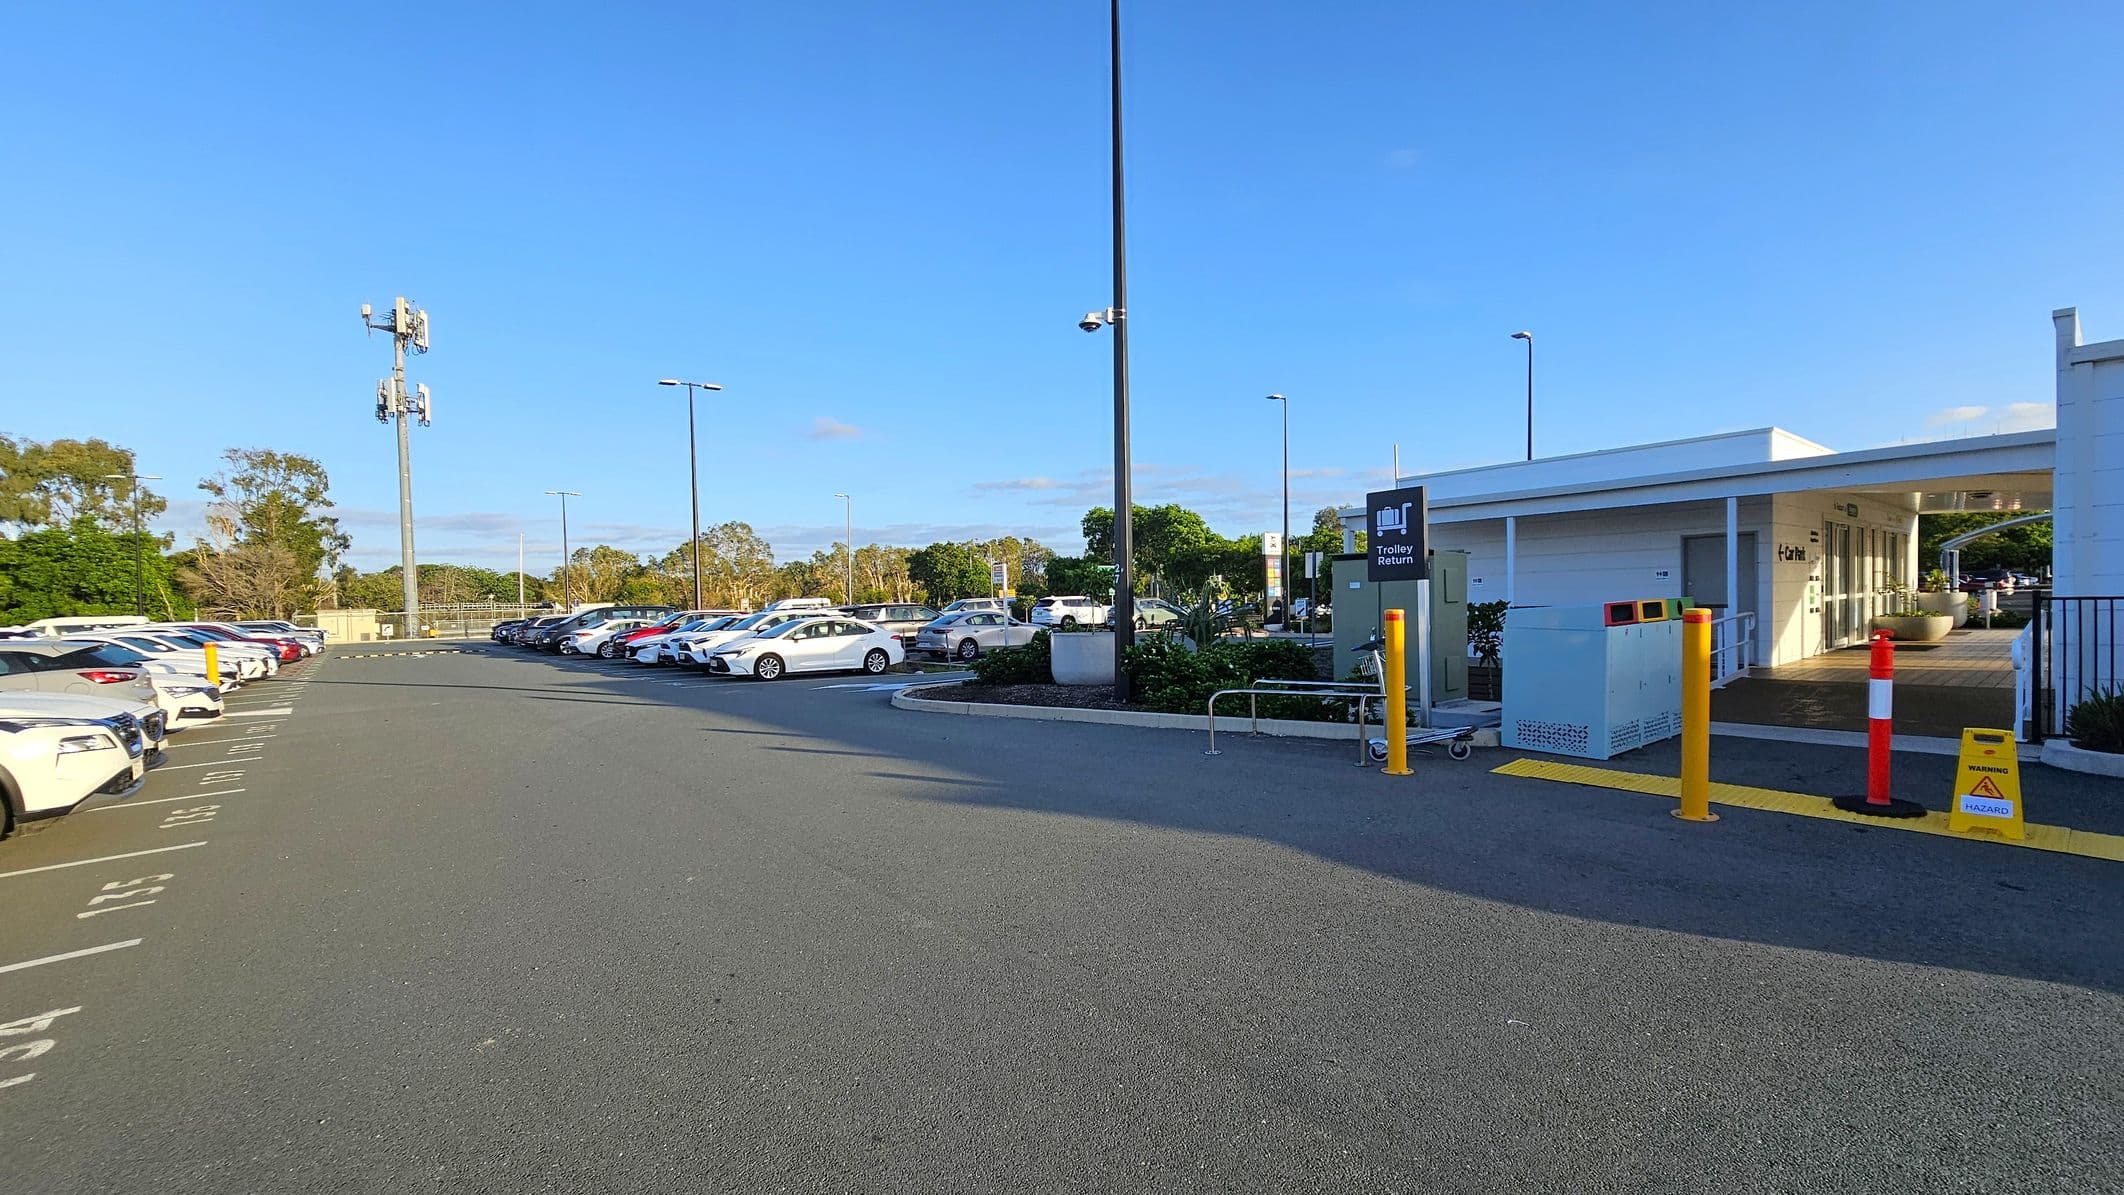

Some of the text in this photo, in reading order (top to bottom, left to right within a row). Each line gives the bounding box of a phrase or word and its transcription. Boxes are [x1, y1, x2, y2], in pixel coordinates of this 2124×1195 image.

[1376, 544, 1413, 555] Trolley
[1378, 556, 1413, 566] Return
[1968, 764, 2009, 774] WARNING
[1965, 802, 2009, 815] HAZARD
